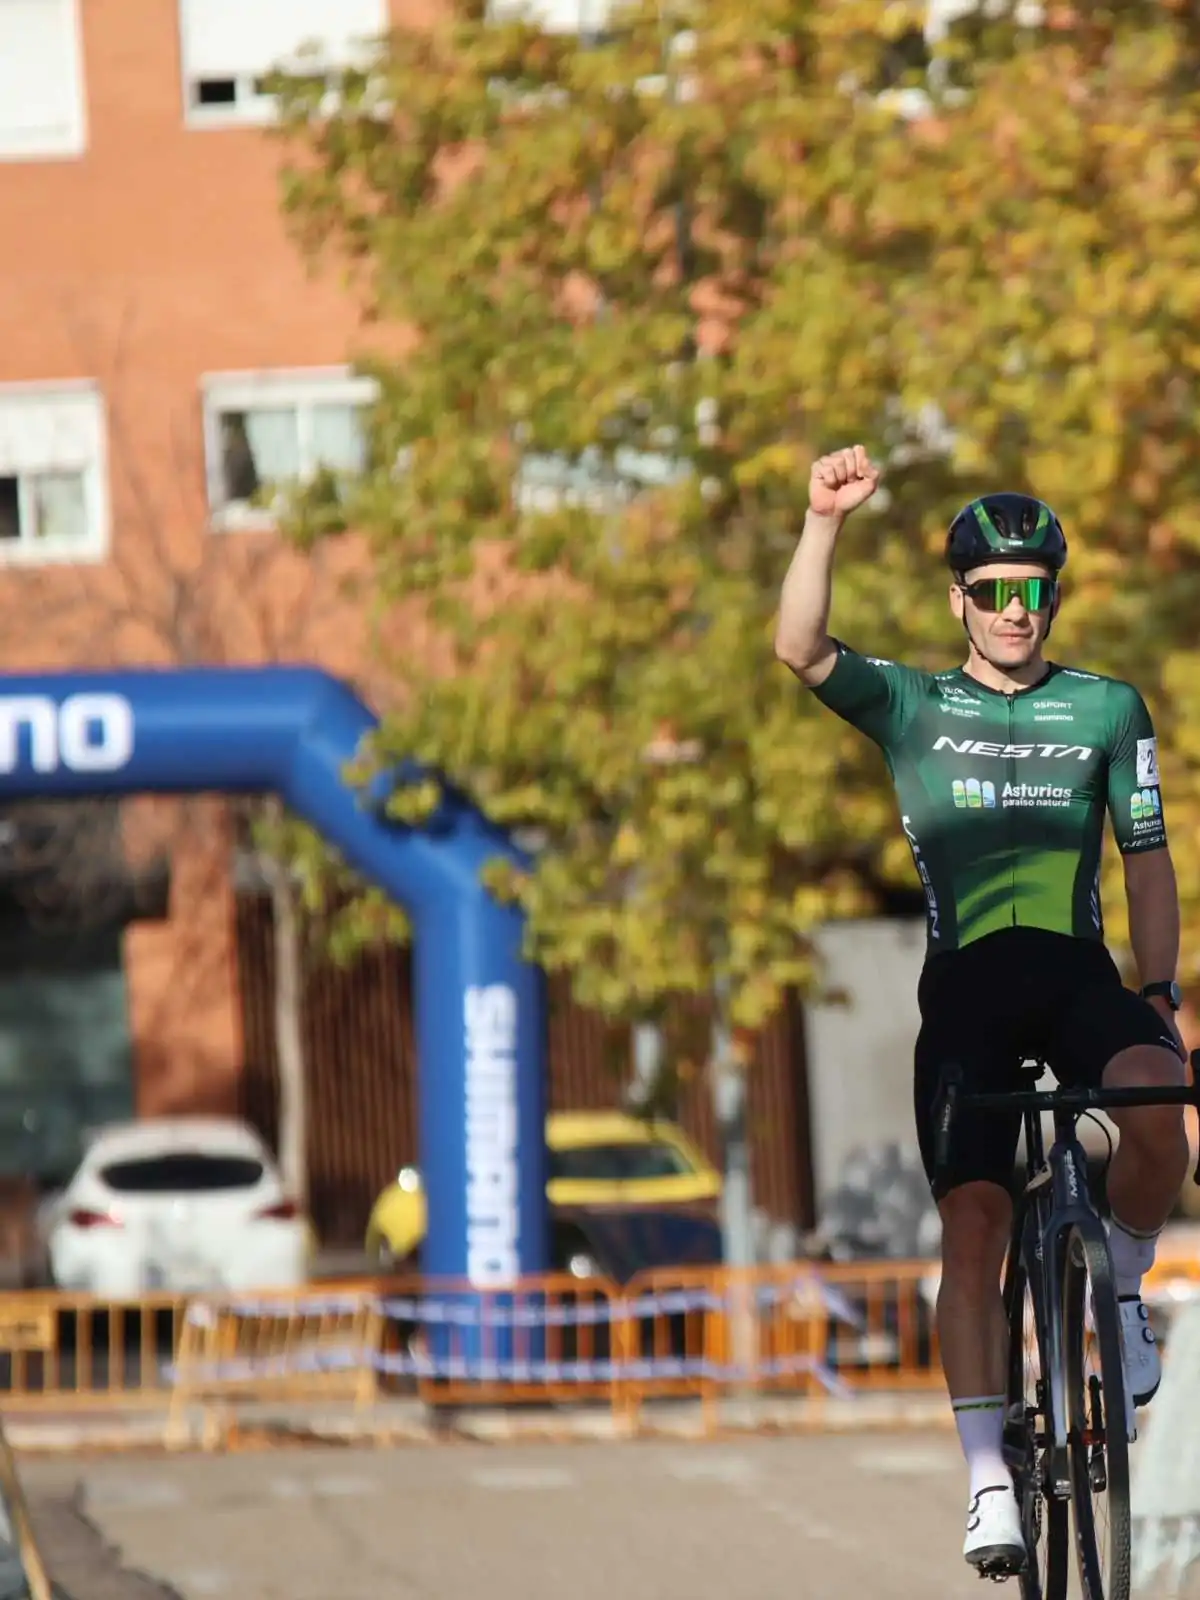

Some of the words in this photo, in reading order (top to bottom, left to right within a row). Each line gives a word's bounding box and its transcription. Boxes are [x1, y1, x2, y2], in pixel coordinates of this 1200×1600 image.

[932, 735, 1093, 761] NESTA
[1002, 781, 1073, 798] Asturias
[1036, 799, 1071, 807] natural
[464, 984, 518, 1288] SHIMANO
